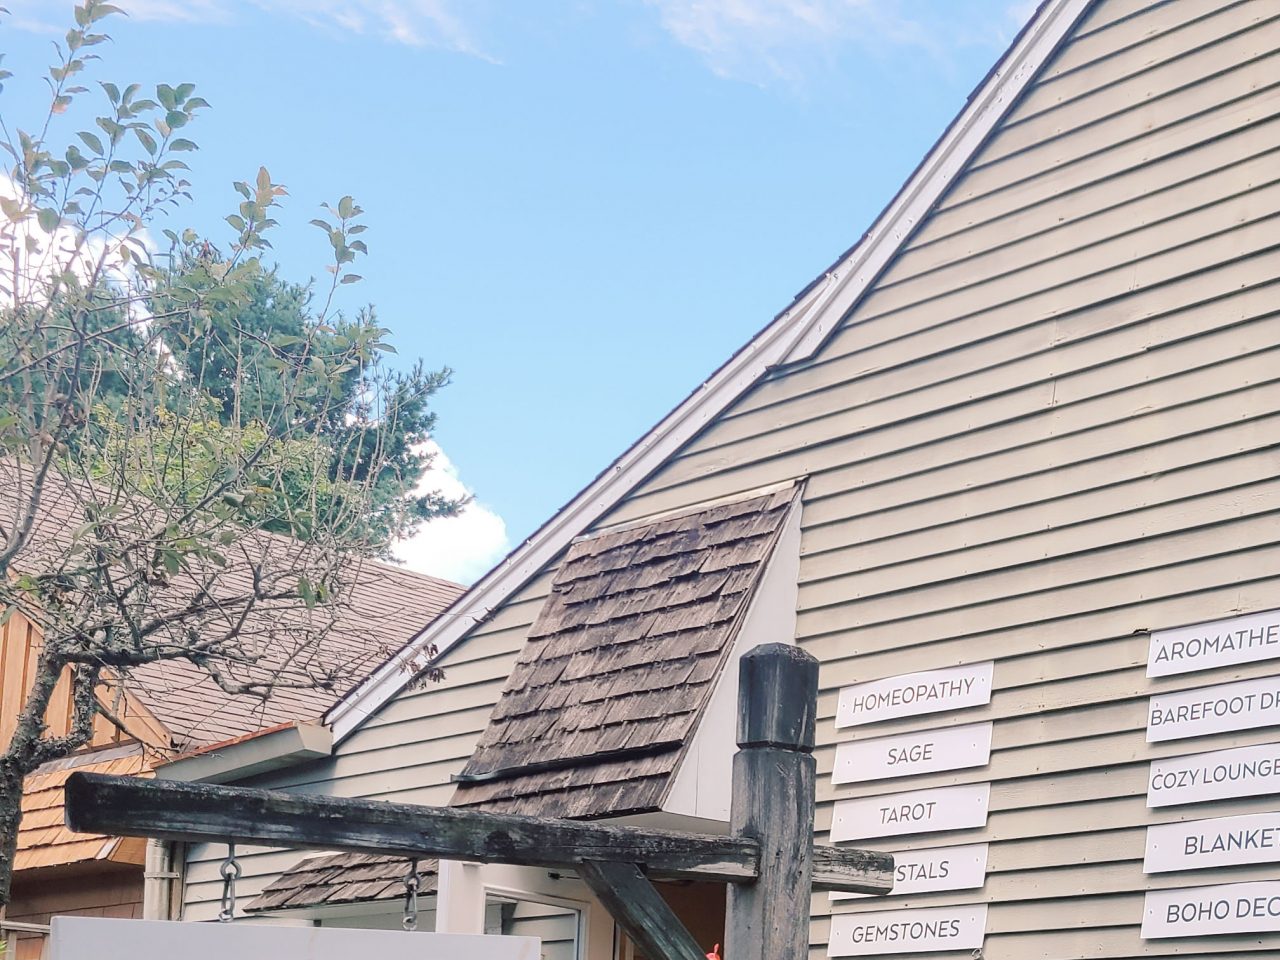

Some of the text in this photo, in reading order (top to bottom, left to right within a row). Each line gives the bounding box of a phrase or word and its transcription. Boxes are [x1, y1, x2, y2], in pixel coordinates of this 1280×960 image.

[852, 677, 975, 713] HOMEOPATHY
[1150, 694, 1256, 726] BAREFOOT
[886, 743, 934, 765] SAGE
[1151, 769, 1200, 791] COZY
[879, 802, 937, 825] TAROT
[1166, 899, 1230, 924] BOHO
[852, 918, 960, 943] GEMSTONES
